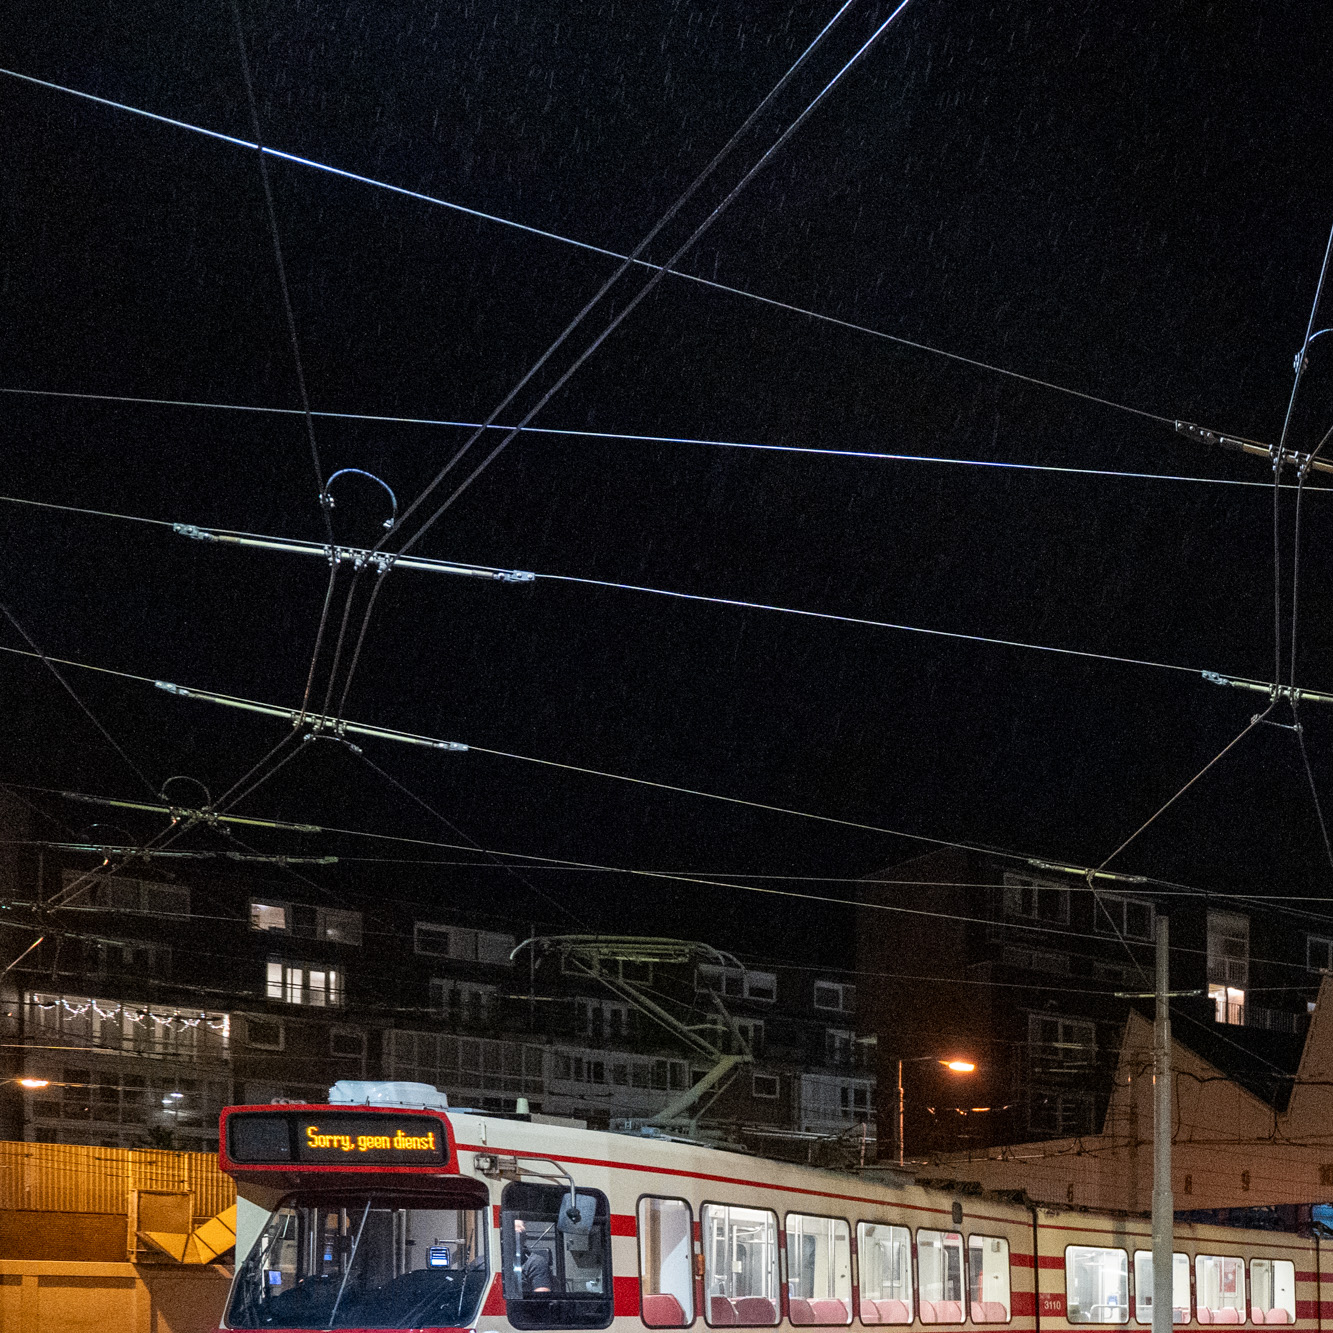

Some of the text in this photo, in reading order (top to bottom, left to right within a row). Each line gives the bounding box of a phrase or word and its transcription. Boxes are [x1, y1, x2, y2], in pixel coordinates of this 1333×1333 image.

[306, 1126, 435, 1152] Sorry, geen dienst
[1044, 1300, 1061, 1310] 3110
